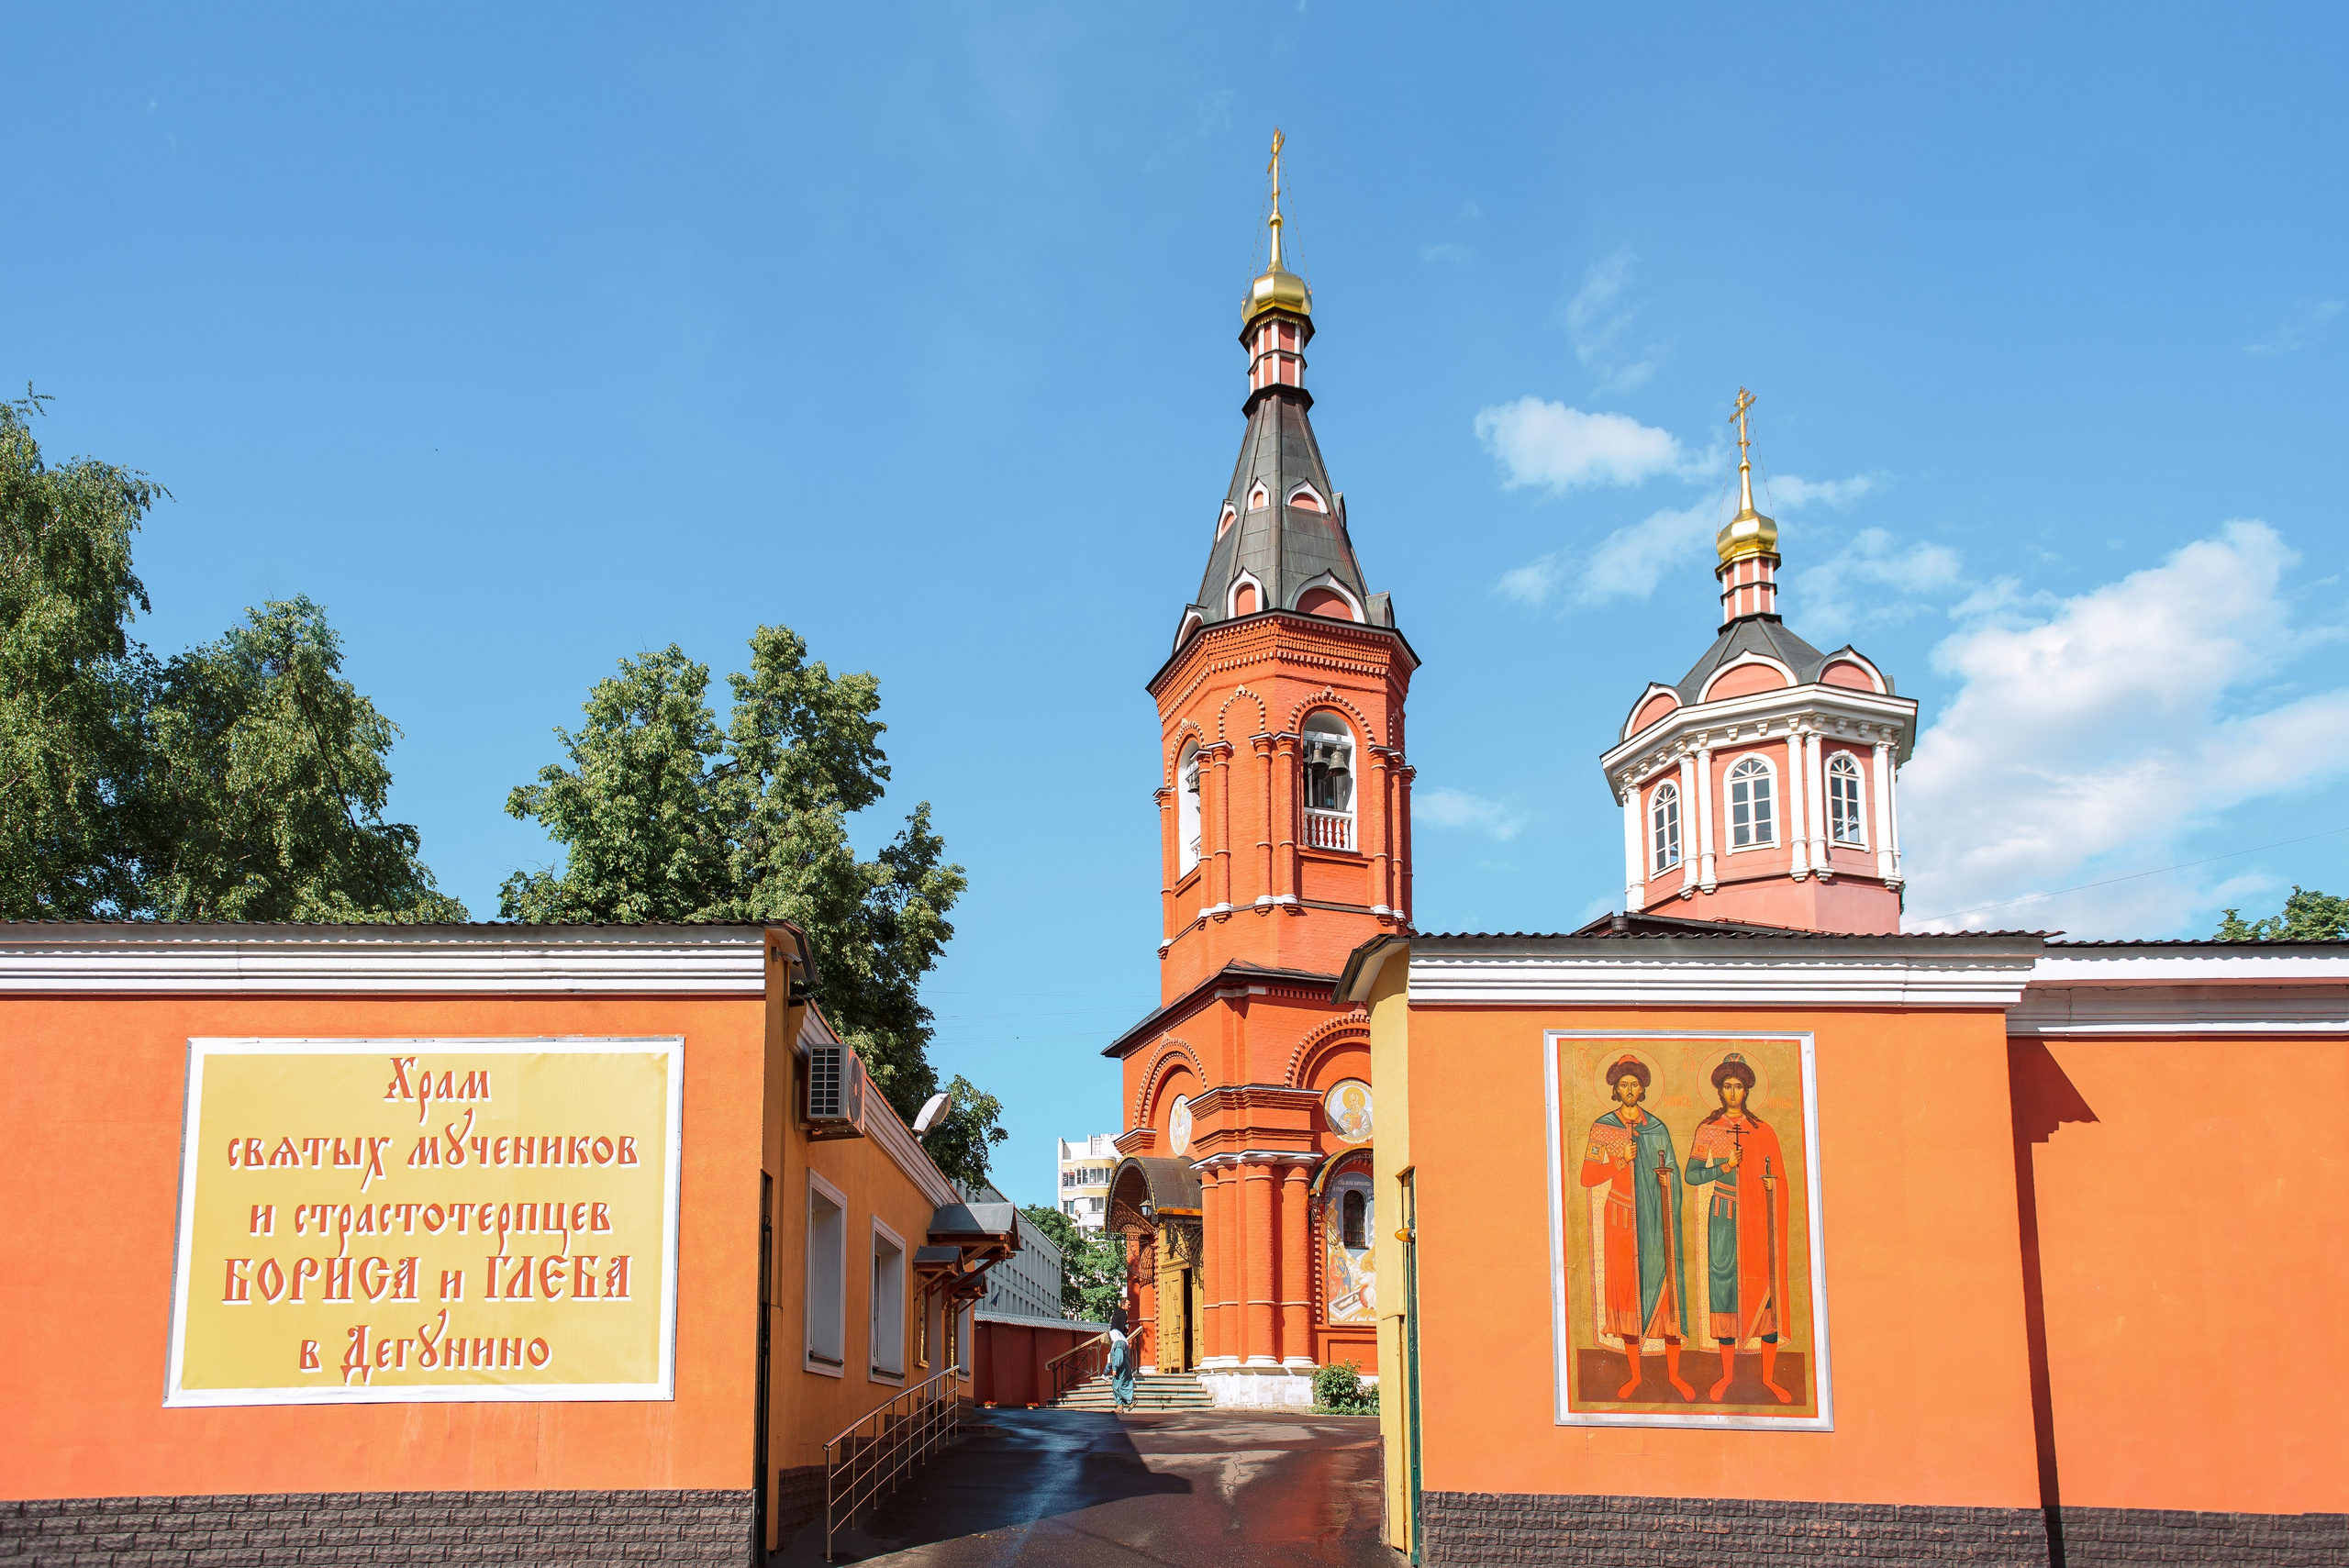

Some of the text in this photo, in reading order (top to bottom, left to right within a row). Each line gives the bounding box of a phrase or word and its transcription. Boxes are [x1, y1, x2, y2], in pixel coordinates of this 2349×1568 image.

[385, 1056, 490, 1124] Храм
[250, 1202, 611, 1257] и страстотерпцев
[222, 1255, 632, 1302] БОРИСА и ГЛЕБА
[299, 1340, 320, 1370] в
